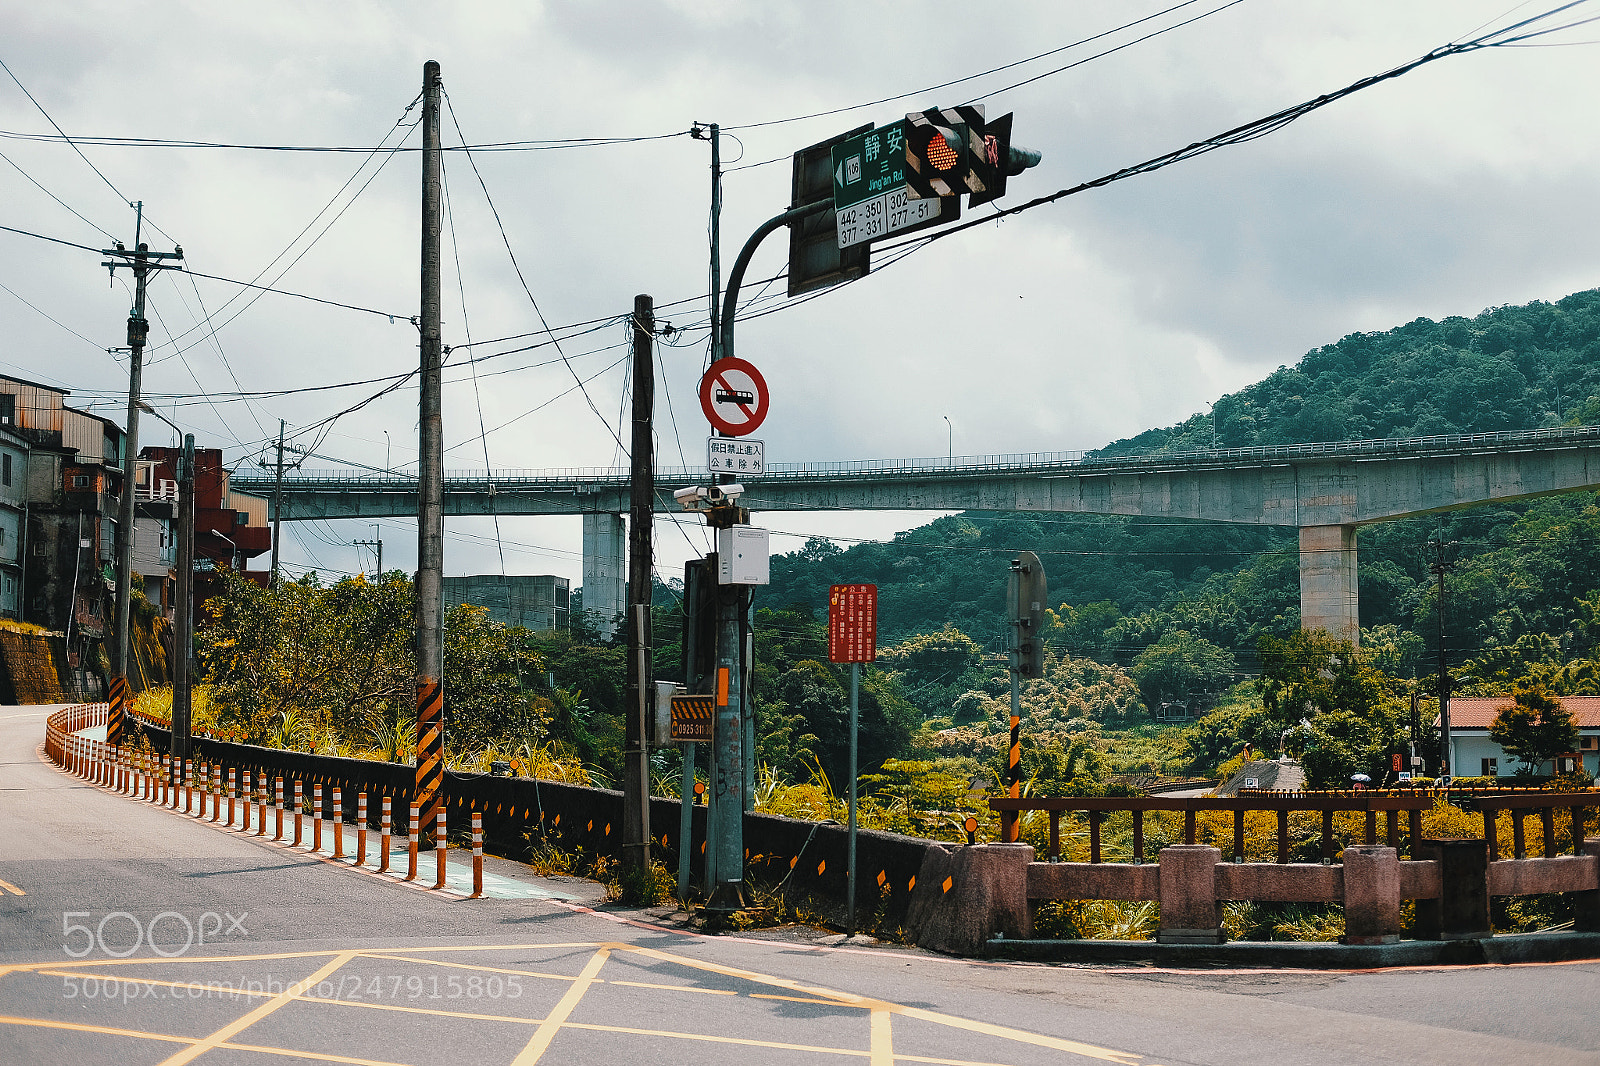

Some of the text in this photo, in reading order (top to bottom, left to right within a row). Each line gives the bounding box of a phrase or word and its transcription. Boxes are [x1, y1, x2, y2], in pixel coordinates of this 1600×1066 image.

[864, 127, 903, 163] 靜安
[848, 162, 859, 177] 106
[868, 176, 892, 191] Jing'an
[890, 191, 908, 210] 302
[841, 209, 857, 227] 442
[865, 201, 882, 219] 350
[891, 209, 908, 228] 277
[918, 202, 929, 219] 51
[841, 228, 857, 244] 377
[866, 218, 882, 236] 331
[711, 442, 761, 455] 假日禁止進入
[711, 457, 761, 470] 公車除外
